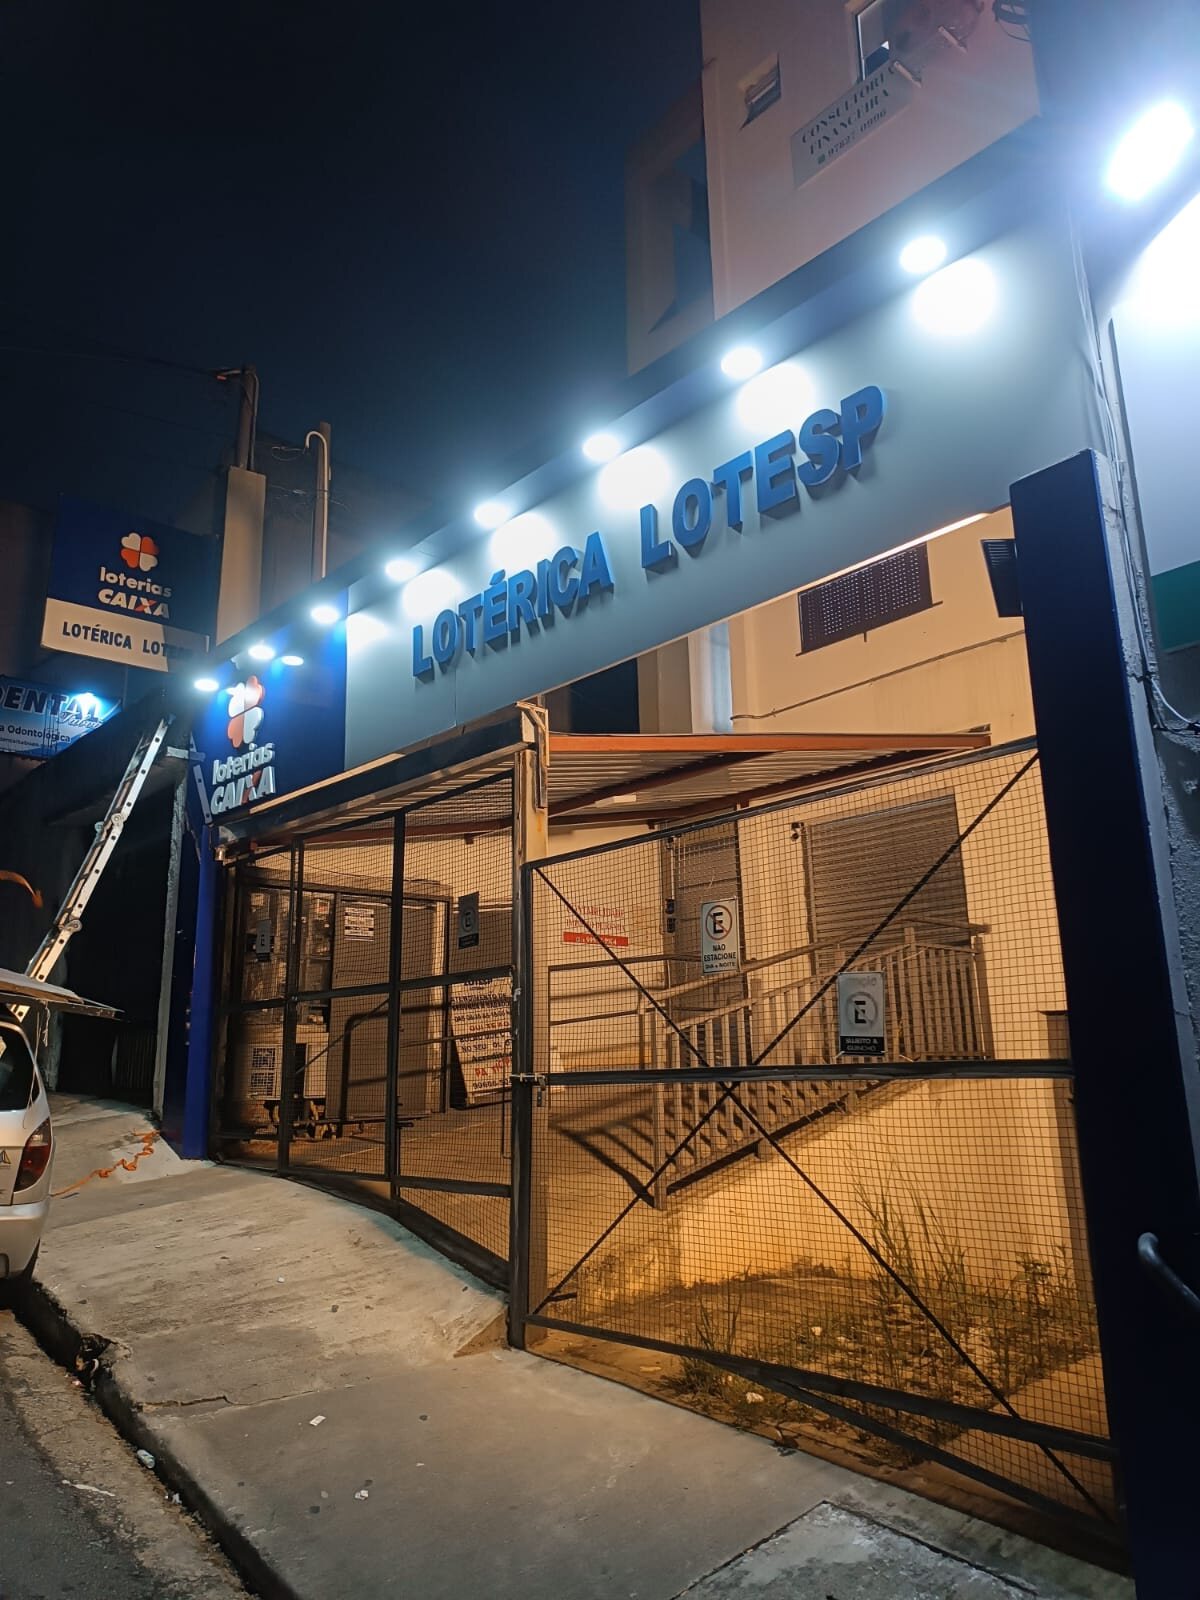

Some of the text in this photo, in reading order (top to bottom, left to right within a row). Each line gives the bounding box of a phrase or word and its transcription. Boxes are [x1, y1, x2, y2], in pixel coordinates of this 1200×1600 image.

[412, 385, 885, 679] LOTÉRICA LOTESP
[100, 566, 172, 598] loterias
[98, 588, 170, 619] CAIXA
[62, 621, 132, 650] LOTÉRICA
[212, 742, 275, 785] loterias
[210, 765, 276, 815] CAIXA
[703, 951, 737, 962] ESTACIONE
